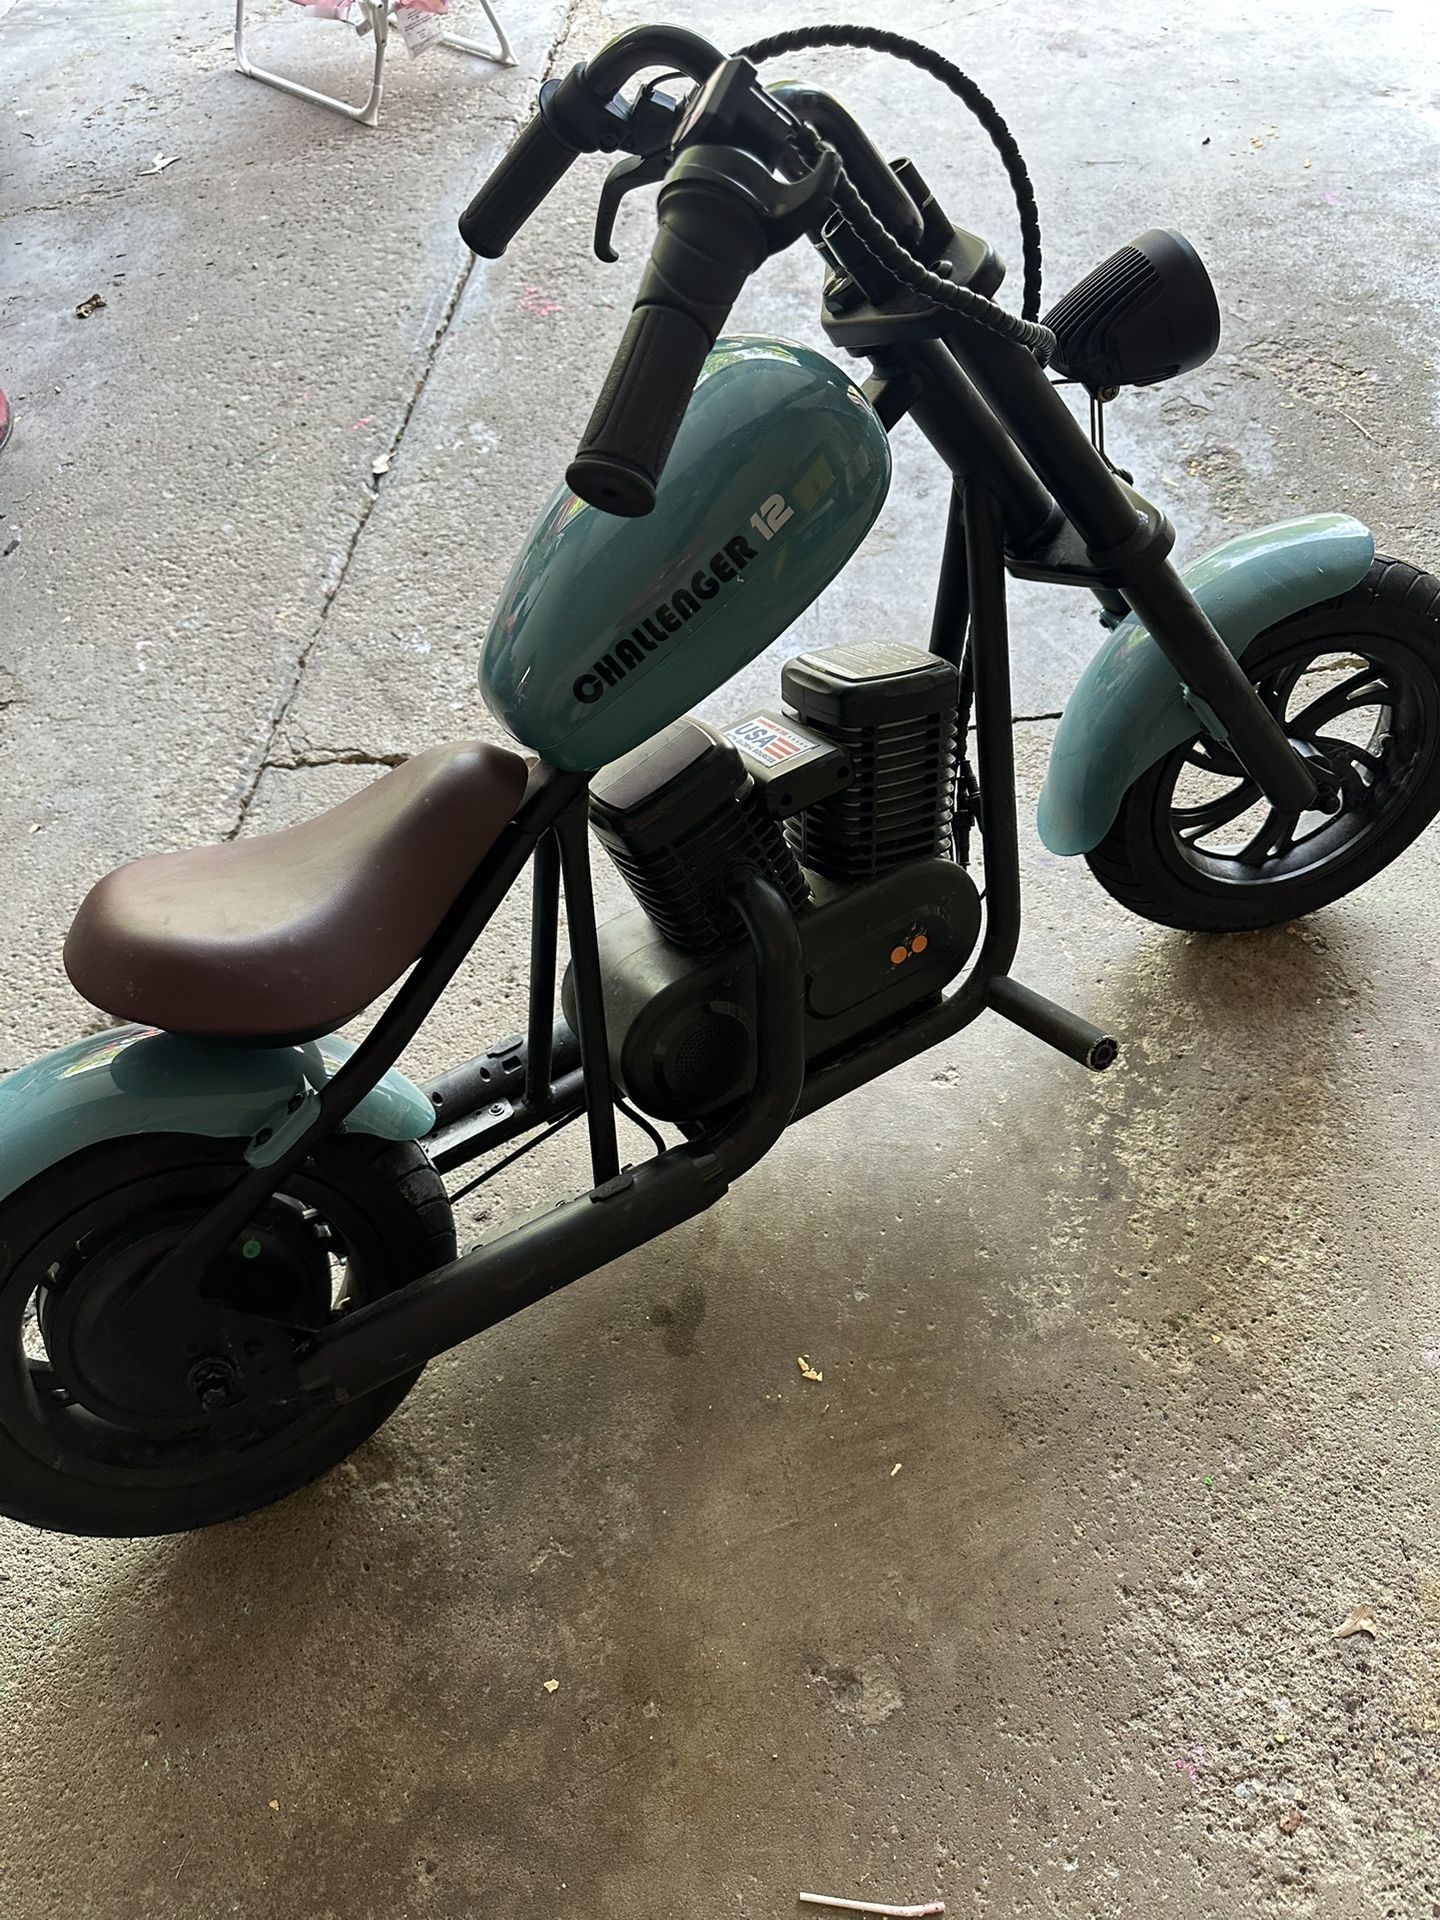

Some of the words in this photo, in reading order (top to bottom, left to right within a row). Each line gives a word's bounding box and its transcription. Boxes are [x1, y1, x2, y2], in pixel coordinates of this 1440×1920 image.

[572, 535, 759, 704] CHALLENGER
[749, 493, 795, 541] 12
[734, 722, 778, 748] USA
